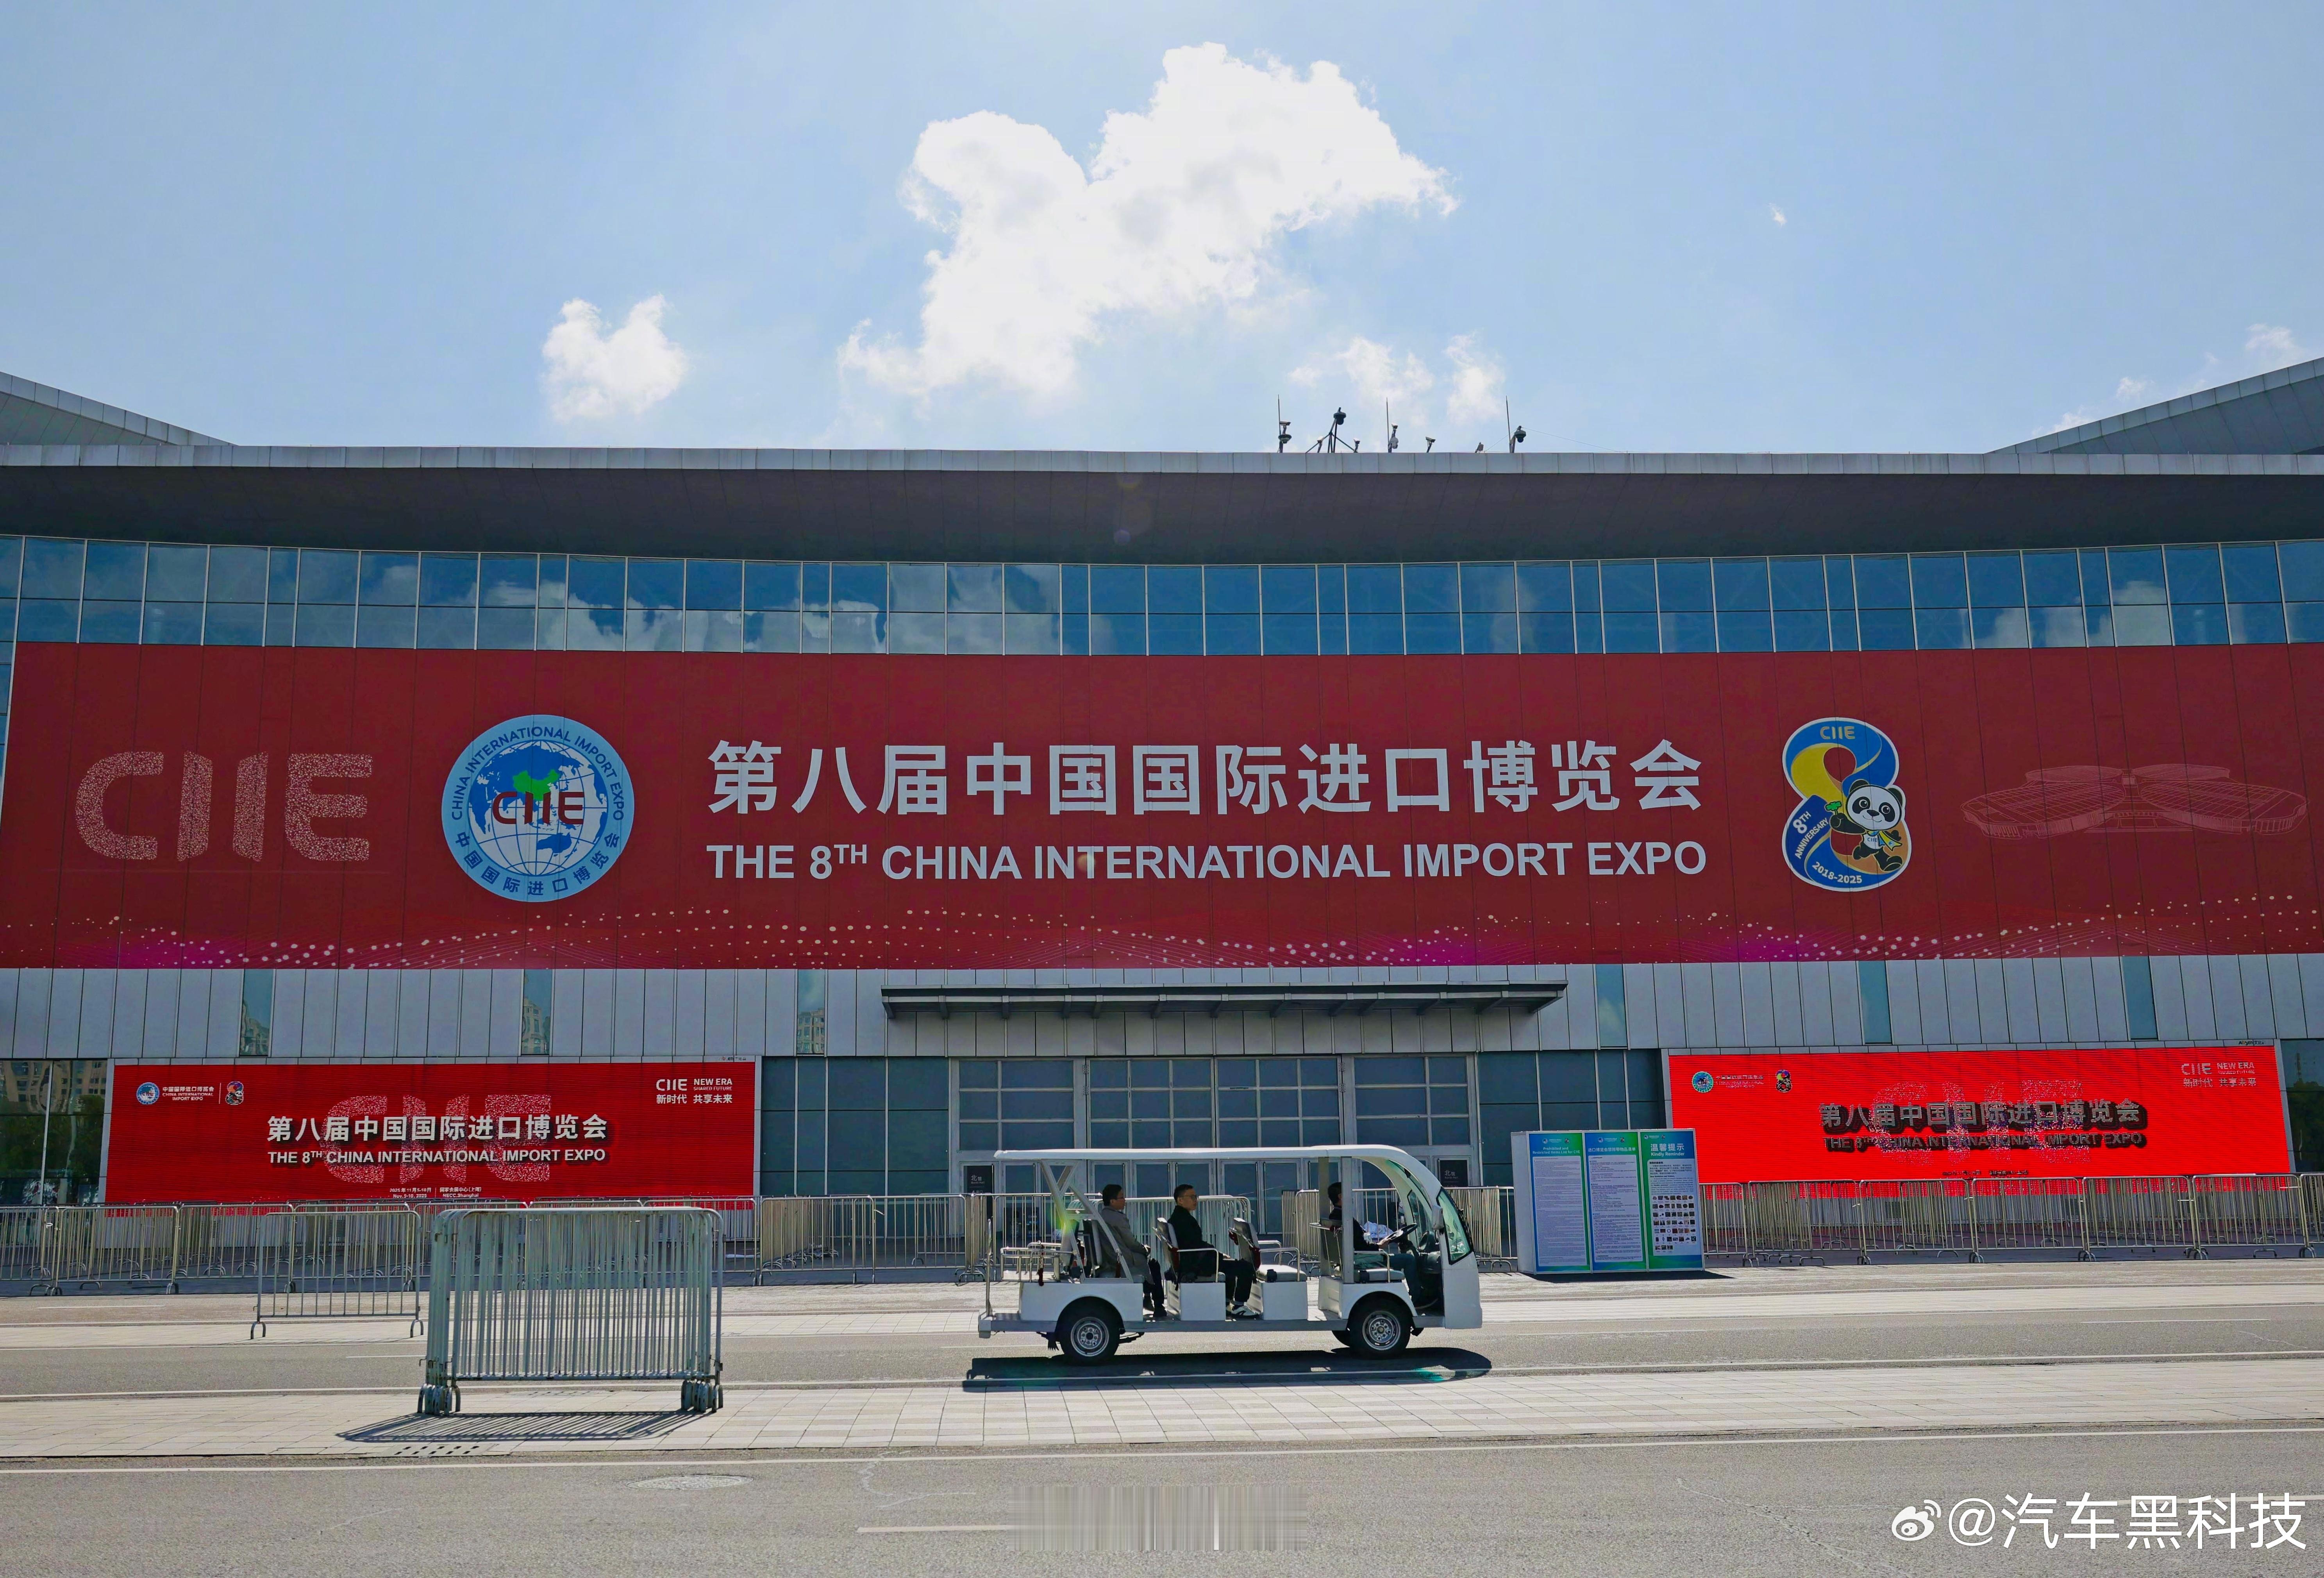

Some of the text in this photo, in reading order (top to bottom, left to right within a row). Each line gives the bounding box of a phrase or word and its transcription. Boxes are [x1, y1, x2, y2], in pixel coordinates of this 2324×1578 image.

[1820, 726, 1855, 740] CIIE
[451, 726, 624, 821] CHINA INTERNATIONAL IMPORT EXPO
[707, 739, 1702, 815] 第八届中国国际进口博览会
[75, 751, 373, 861] CIIE
[492, 791, 585, 825] CIIE
[1795, 818, 1829, 859] ANNIVERSARY
[456, 831, 620, 896] 中国国际进口博览会
[706, 841, 1706, 879] THE 8TH CHINA INTERNATIONAL IMPORT EXPO
[1812, 861, 1862, 883] 2018-2025
[2181, 1063, 2212, 1075] CIIE
[656, 1079, 688, 1091] CIIE
[656, 1094, 732, 1104] 新时代 共享未来
[267, 1114, 607, 1141] 第八届中国国际进口博览会
[1651, 1143, 1684, 1151] 温馨提示
[1823, 1137, 1851, 1148] THE
[268, 1149, 606, 1163] THE 8TH CHINA INTERNATIONAL IMPORT EXPO
